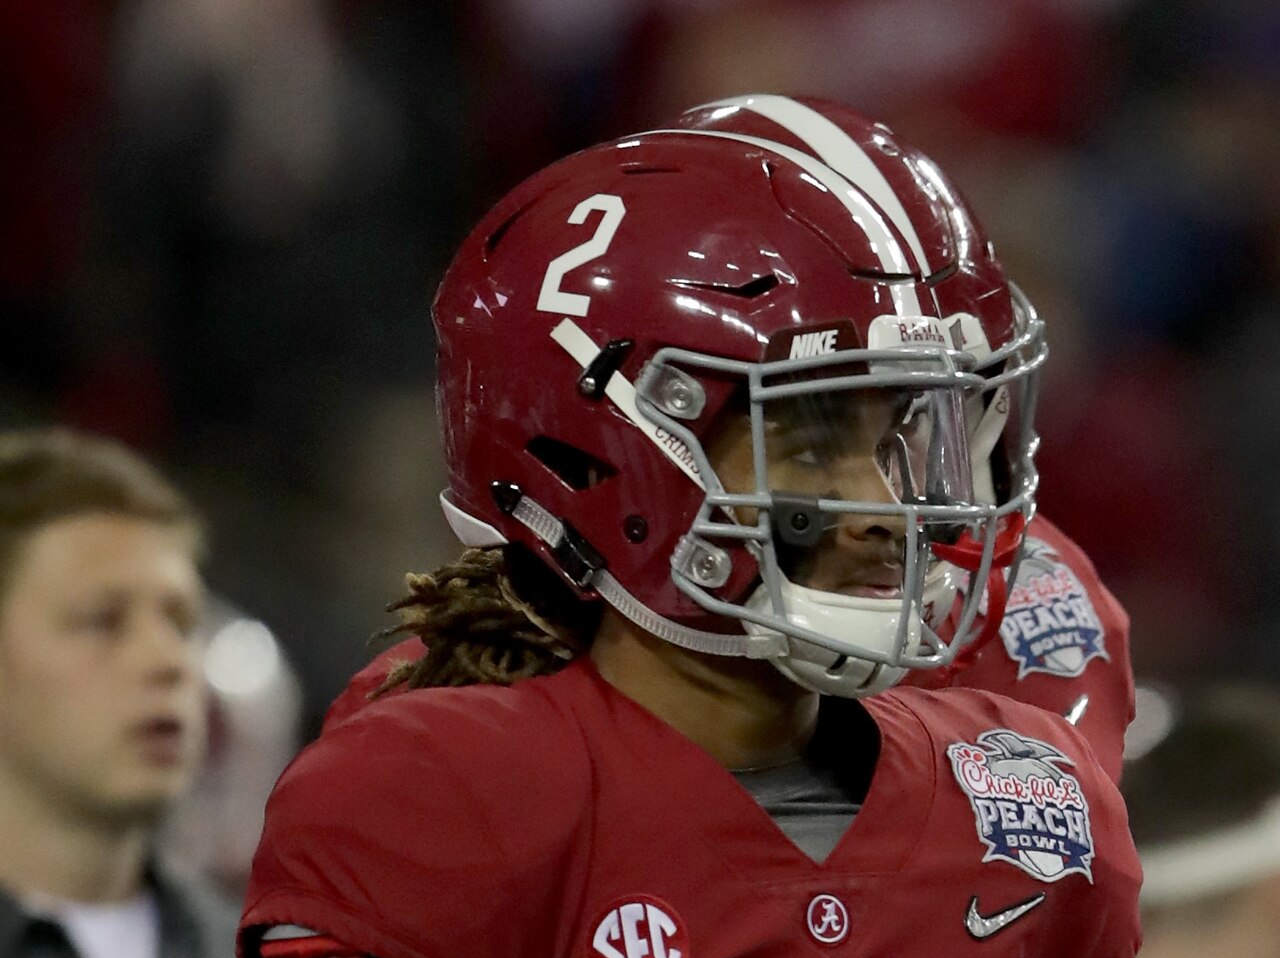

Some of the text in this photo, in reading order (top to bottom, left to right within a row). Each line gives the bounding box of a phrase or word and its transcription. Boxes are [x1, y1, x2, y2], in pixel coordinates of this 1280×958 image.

[536, 193, 627, 317] 2
[790, 329, 839, 360] NIKE
[1000, 599, 1098, 656] PEACH
[975, 798, 1089, 847] PEACH
[1005, 834, 1071, 855] BOWL
[814, 901, 841, 934] A
